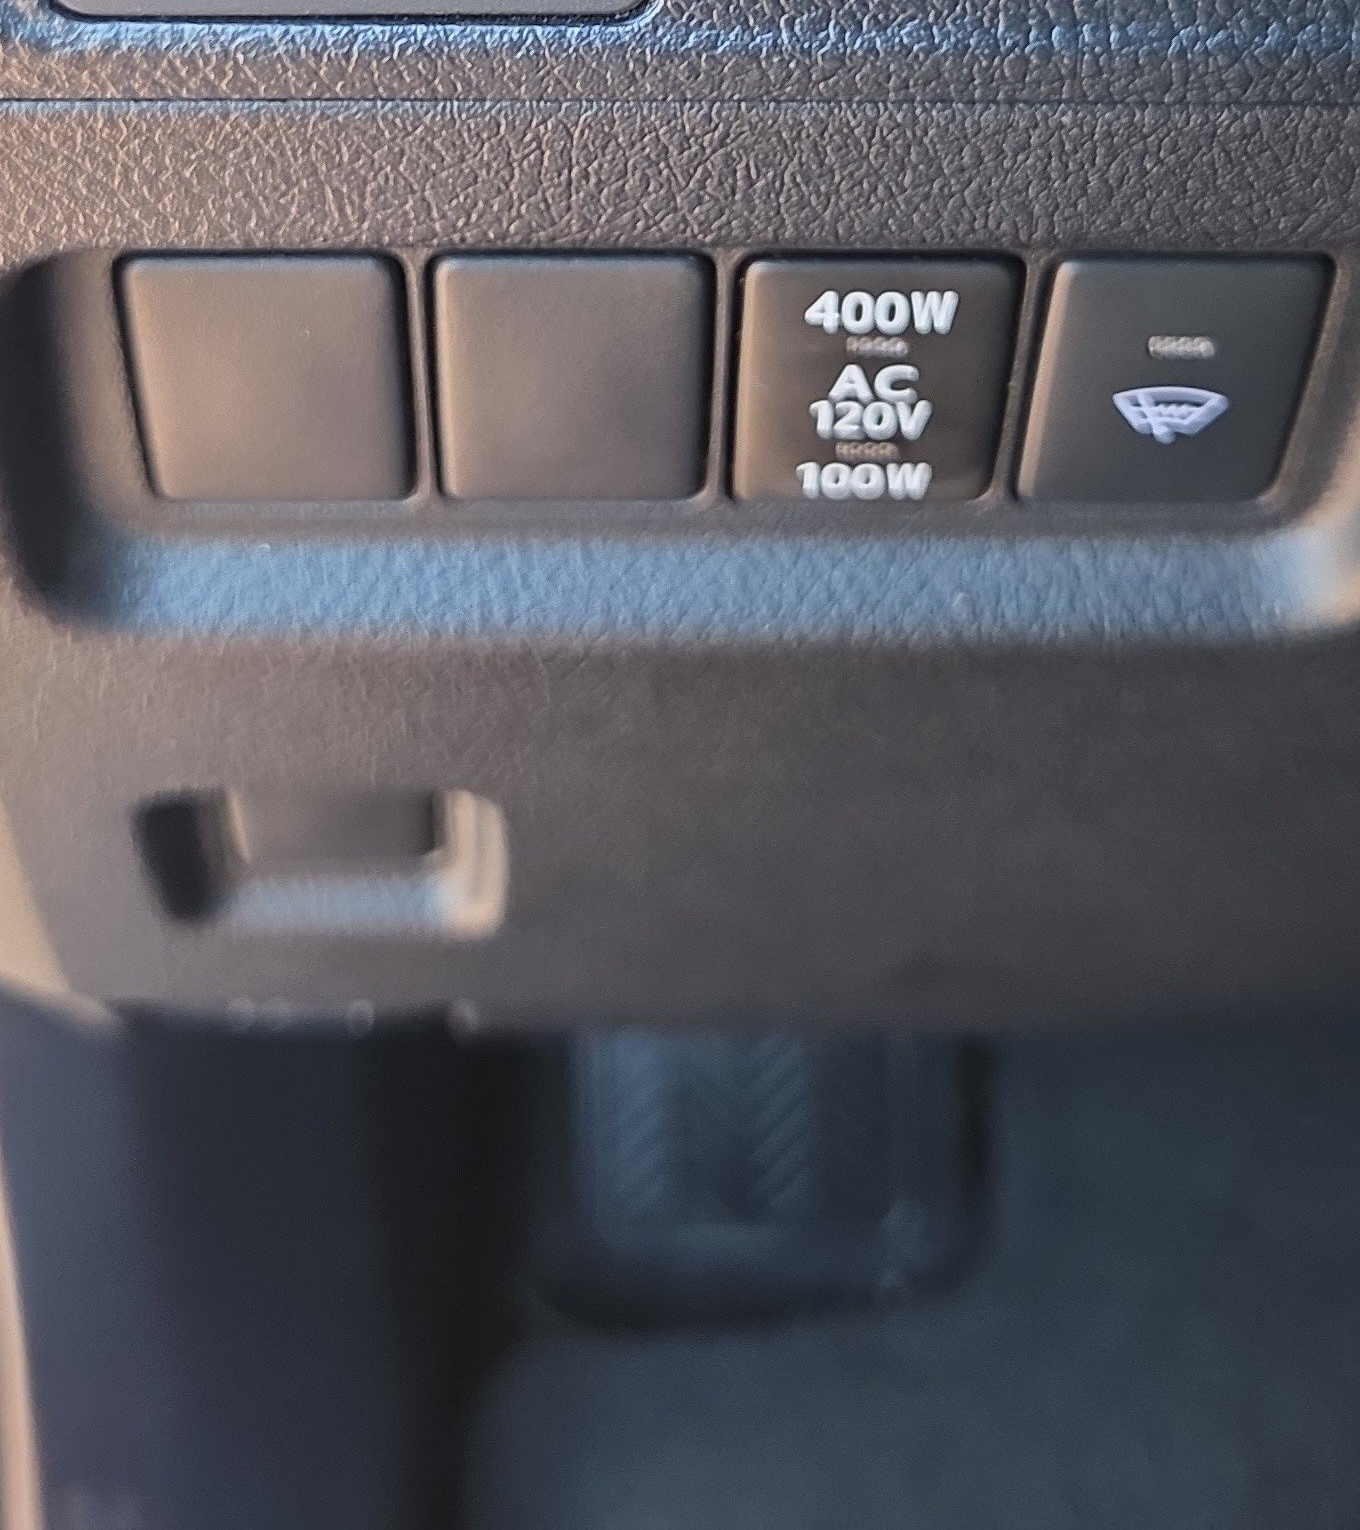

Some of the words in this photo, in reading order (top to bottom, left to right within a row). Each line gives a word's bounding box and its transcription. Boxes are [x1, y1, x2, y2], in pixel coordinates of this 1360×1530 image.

[804, 289, 960, 335] 400W
[828, 363, 920, 404] AC
[809, 399, 933, 441] 120V
[795, 461, 933, 501] 100W
